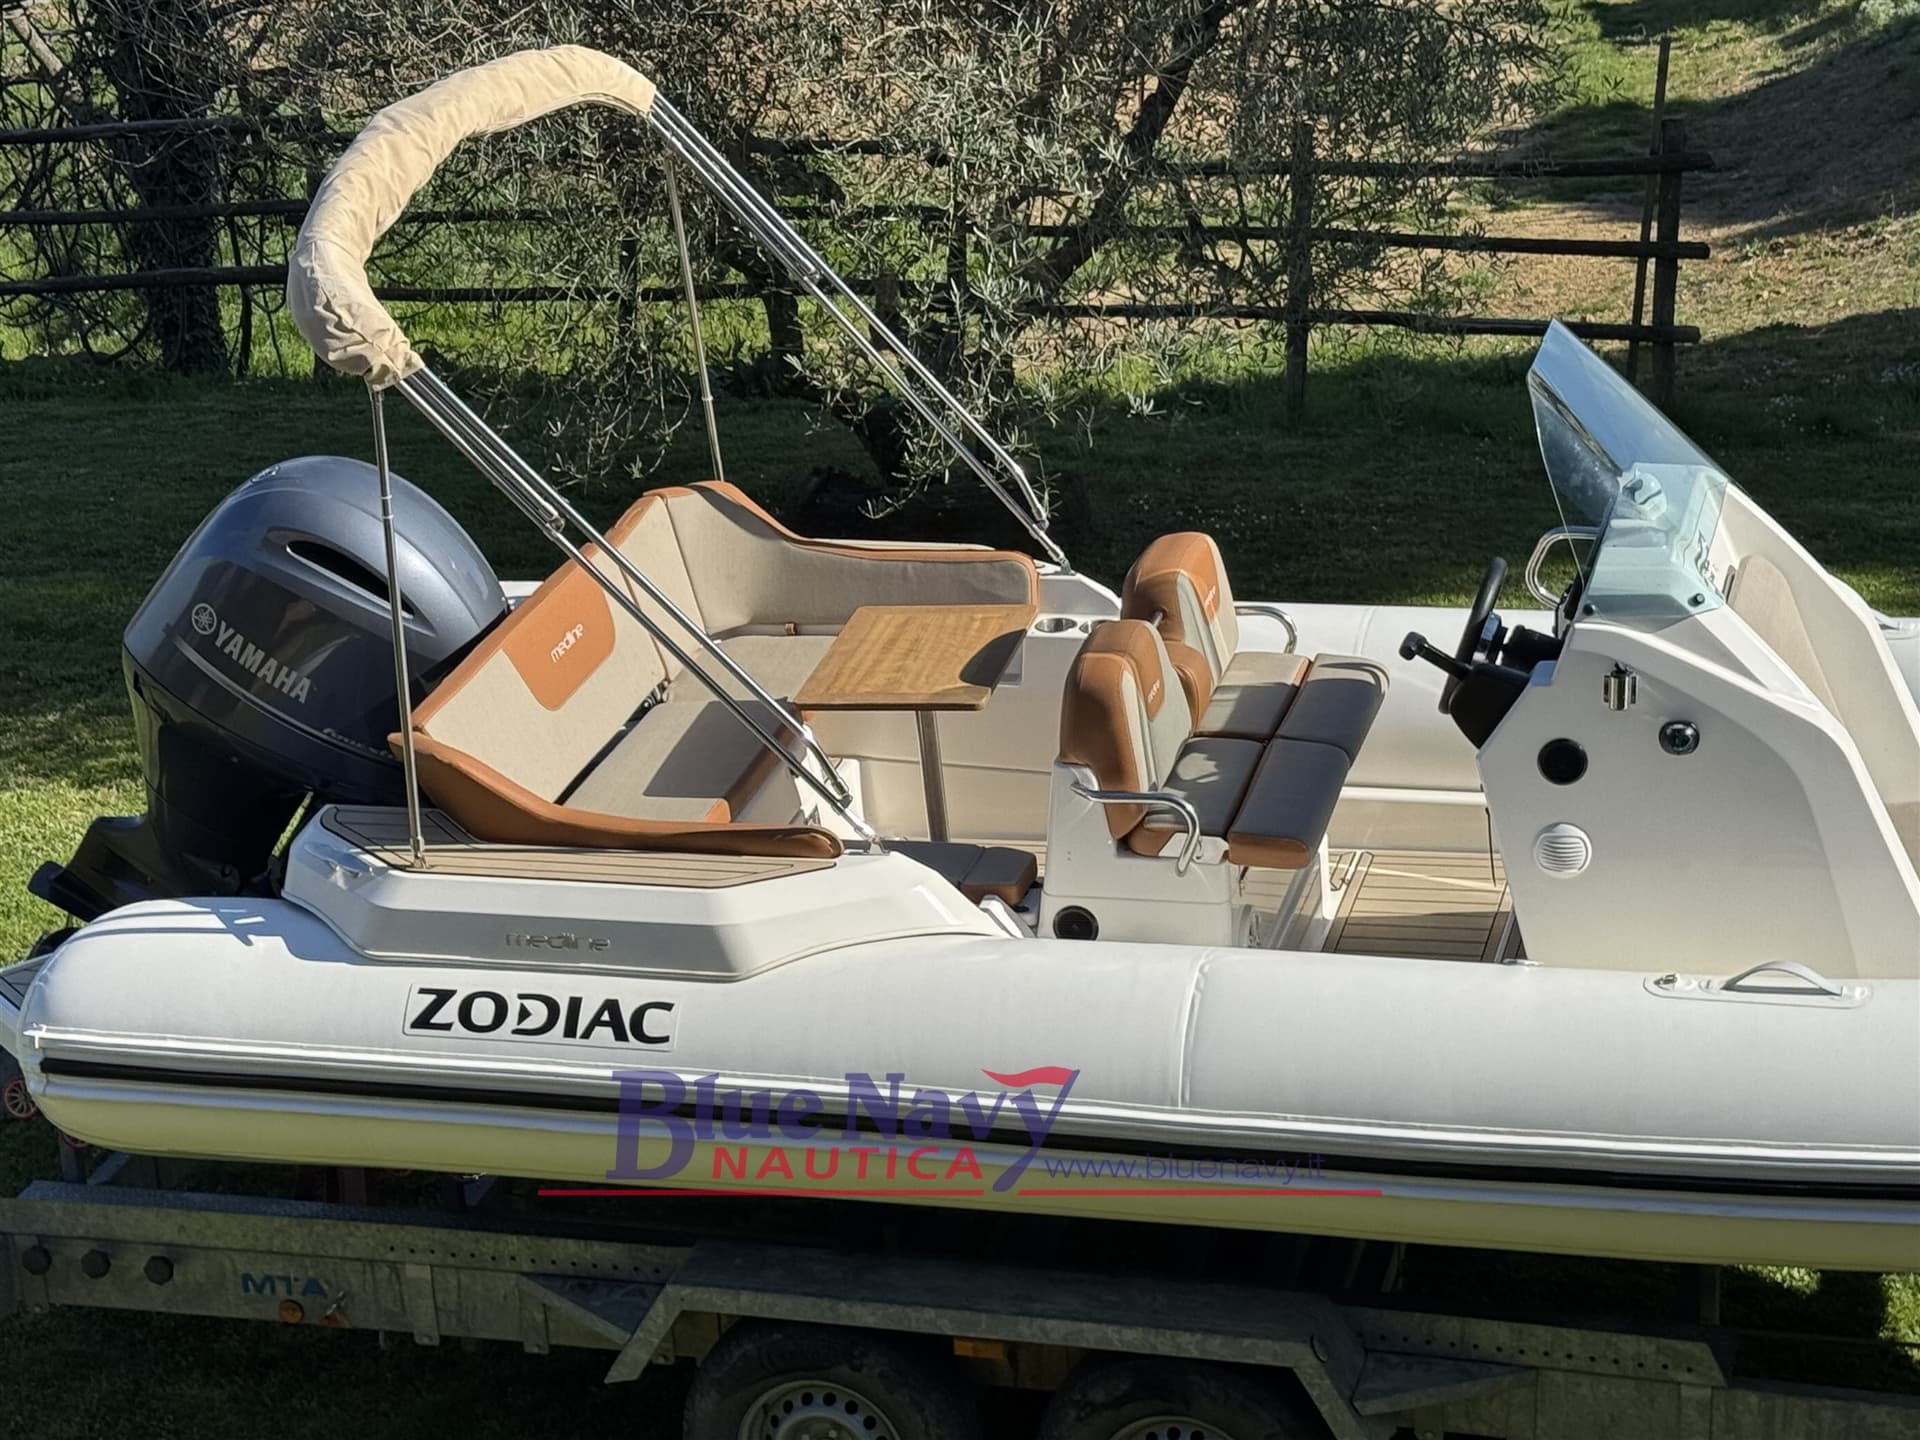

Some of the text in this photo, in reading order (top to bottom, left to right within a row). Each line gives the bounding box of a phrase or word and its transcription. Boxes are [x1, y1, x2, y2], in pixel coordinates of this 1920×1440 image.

[213, 620, 312, 704] YAMAHA
[409, 987, 675, 1045] ZODIAC
[240, 1273, 328, 1299] MTA
